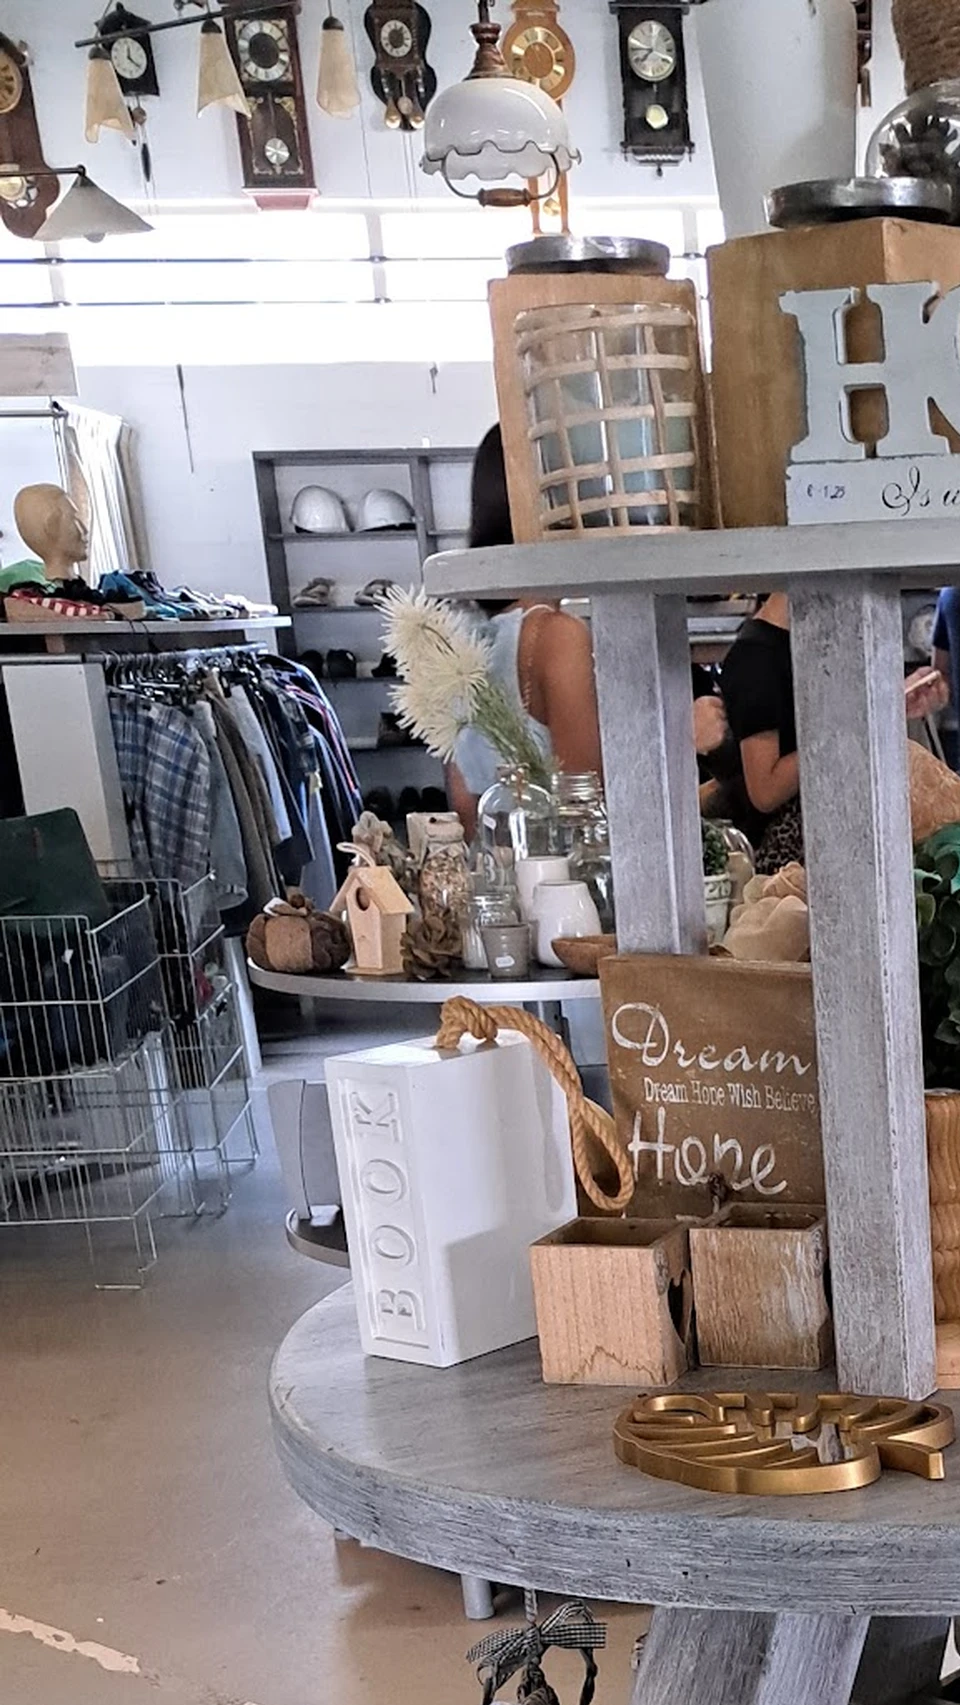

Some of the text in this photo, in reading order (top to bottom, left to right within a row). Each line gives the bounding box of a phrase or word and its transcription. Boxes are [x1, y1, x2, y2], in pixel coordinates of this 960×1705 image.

[881, 466, 931, 516] Is
[612, 1002, 812, 1076] Dream
[643, 1077, 689, 1104] Dream
[726, 1083, 762, 1109] Wish
[352, 1090, 427, 1332] BOOK
